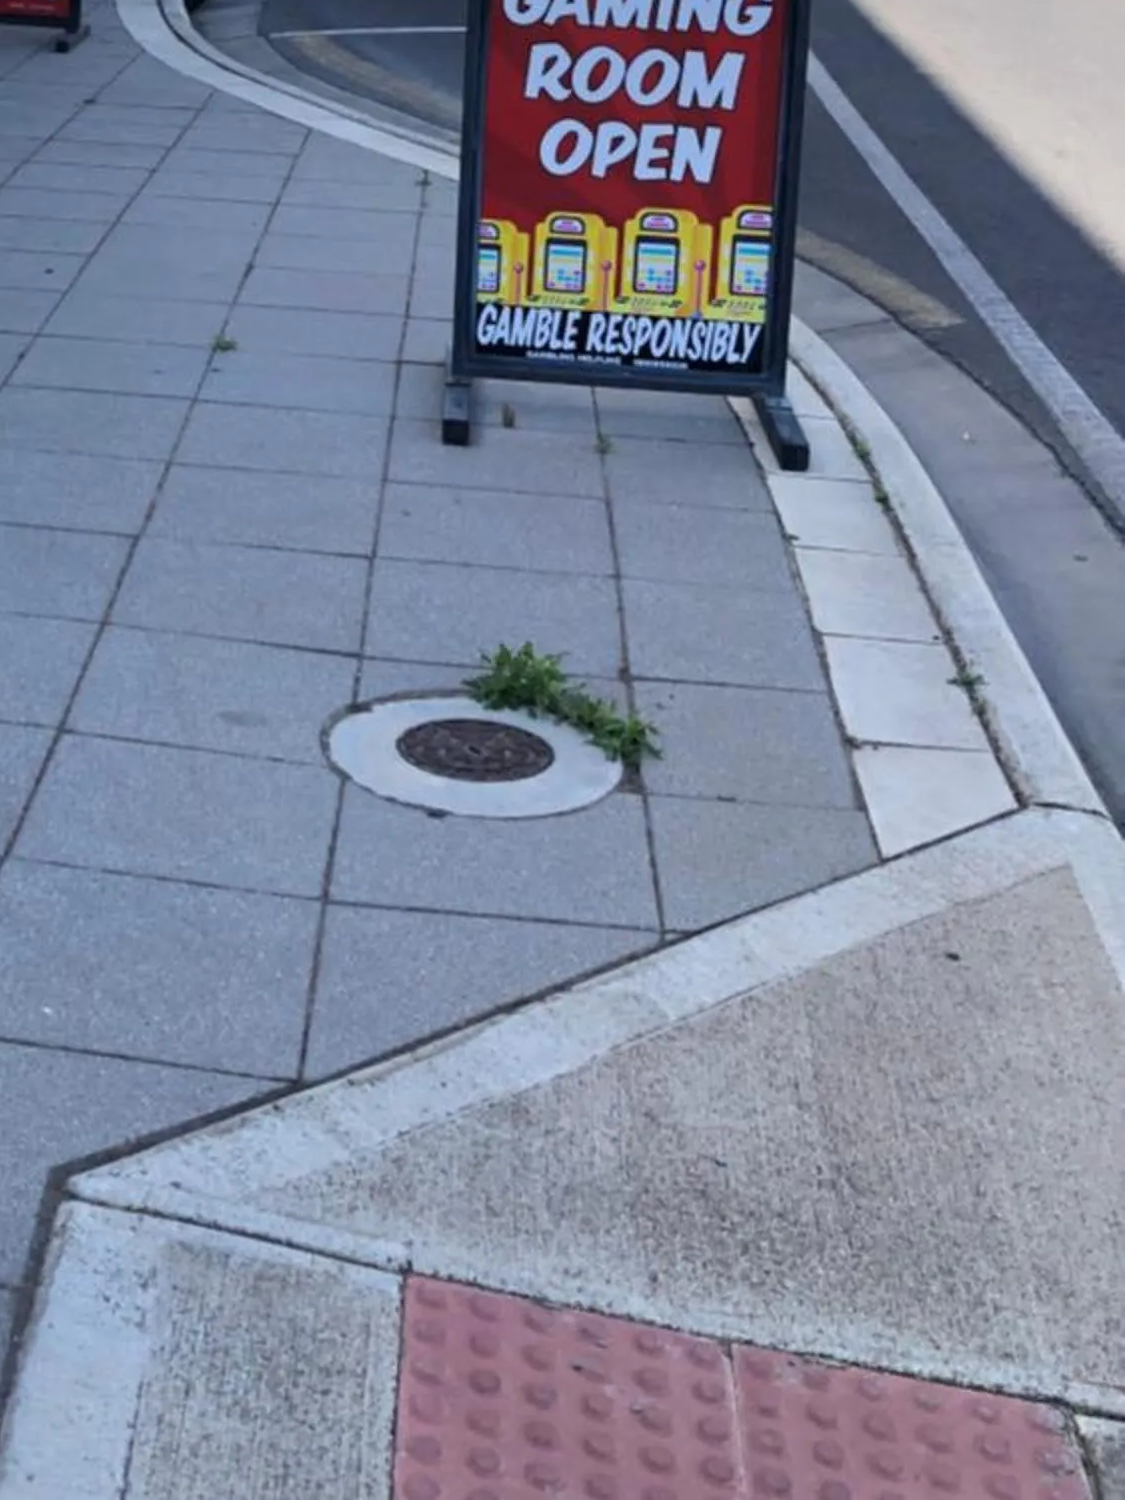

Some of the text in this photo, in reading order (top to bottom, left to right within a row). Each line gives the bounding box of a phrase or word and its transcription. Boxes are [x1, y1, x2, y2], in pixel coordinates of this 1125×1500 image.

[524, 42, 746, 111] ROOM
[539, 118, 722, 184] OPEN
[476, 303, 761, 365] GAMBLE RESPONSIBLY
